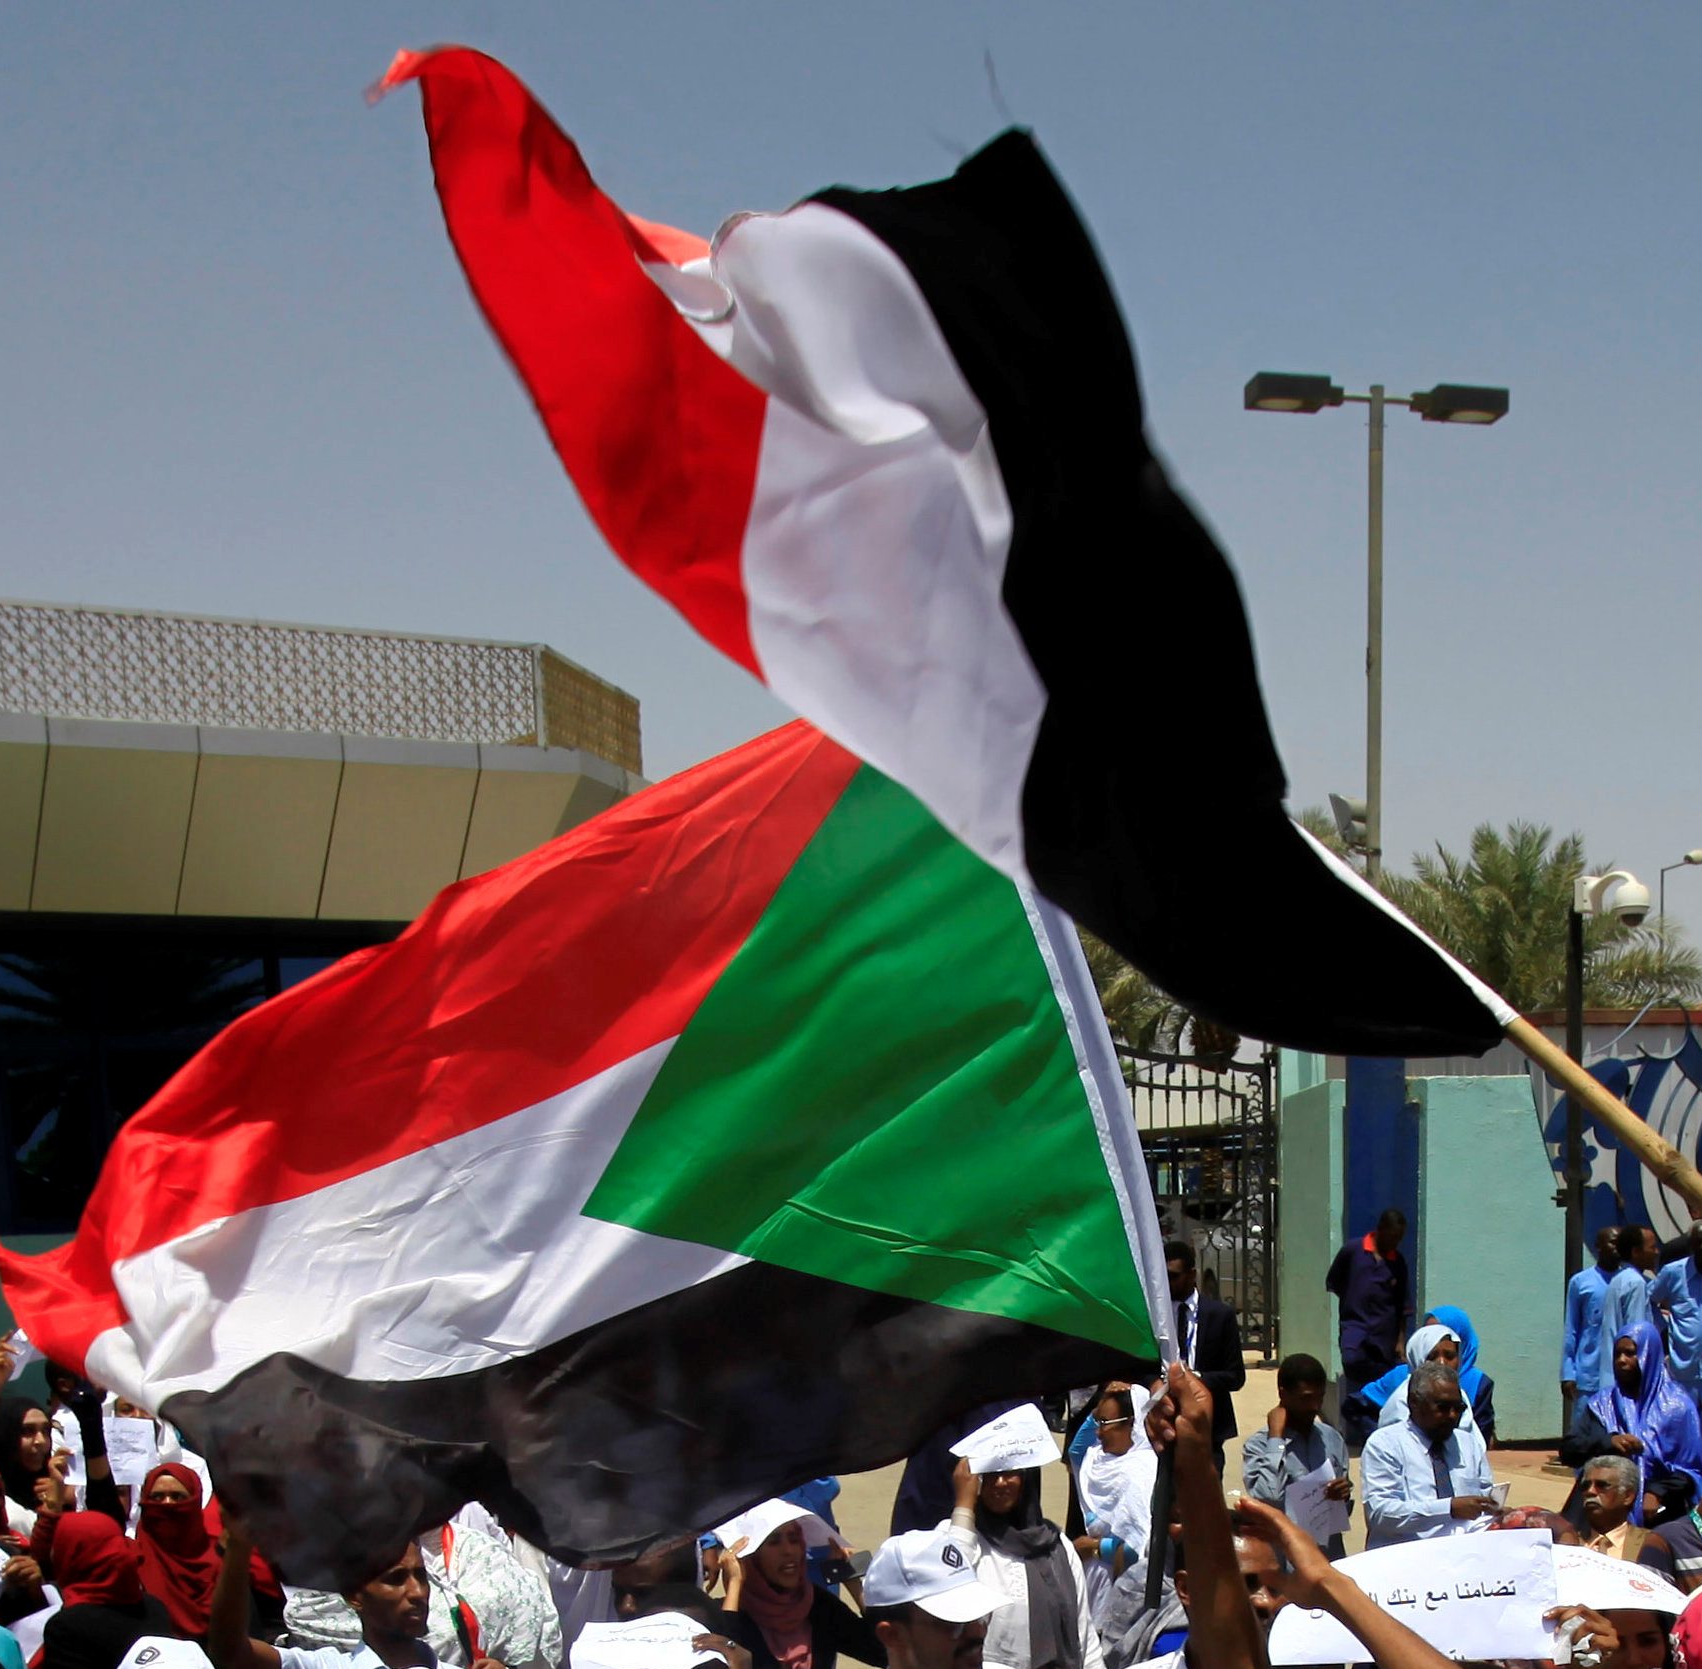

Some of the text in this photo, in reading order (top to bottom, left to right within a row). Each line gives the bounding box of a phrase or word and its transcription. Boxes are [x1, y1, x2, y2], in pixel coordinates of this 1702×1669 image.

[1387, 1588, 1418, 1609] بنك
[1425, 1590, 1449, 1611] مع
[1455, 1581, 1516, 1600] تضامنا
